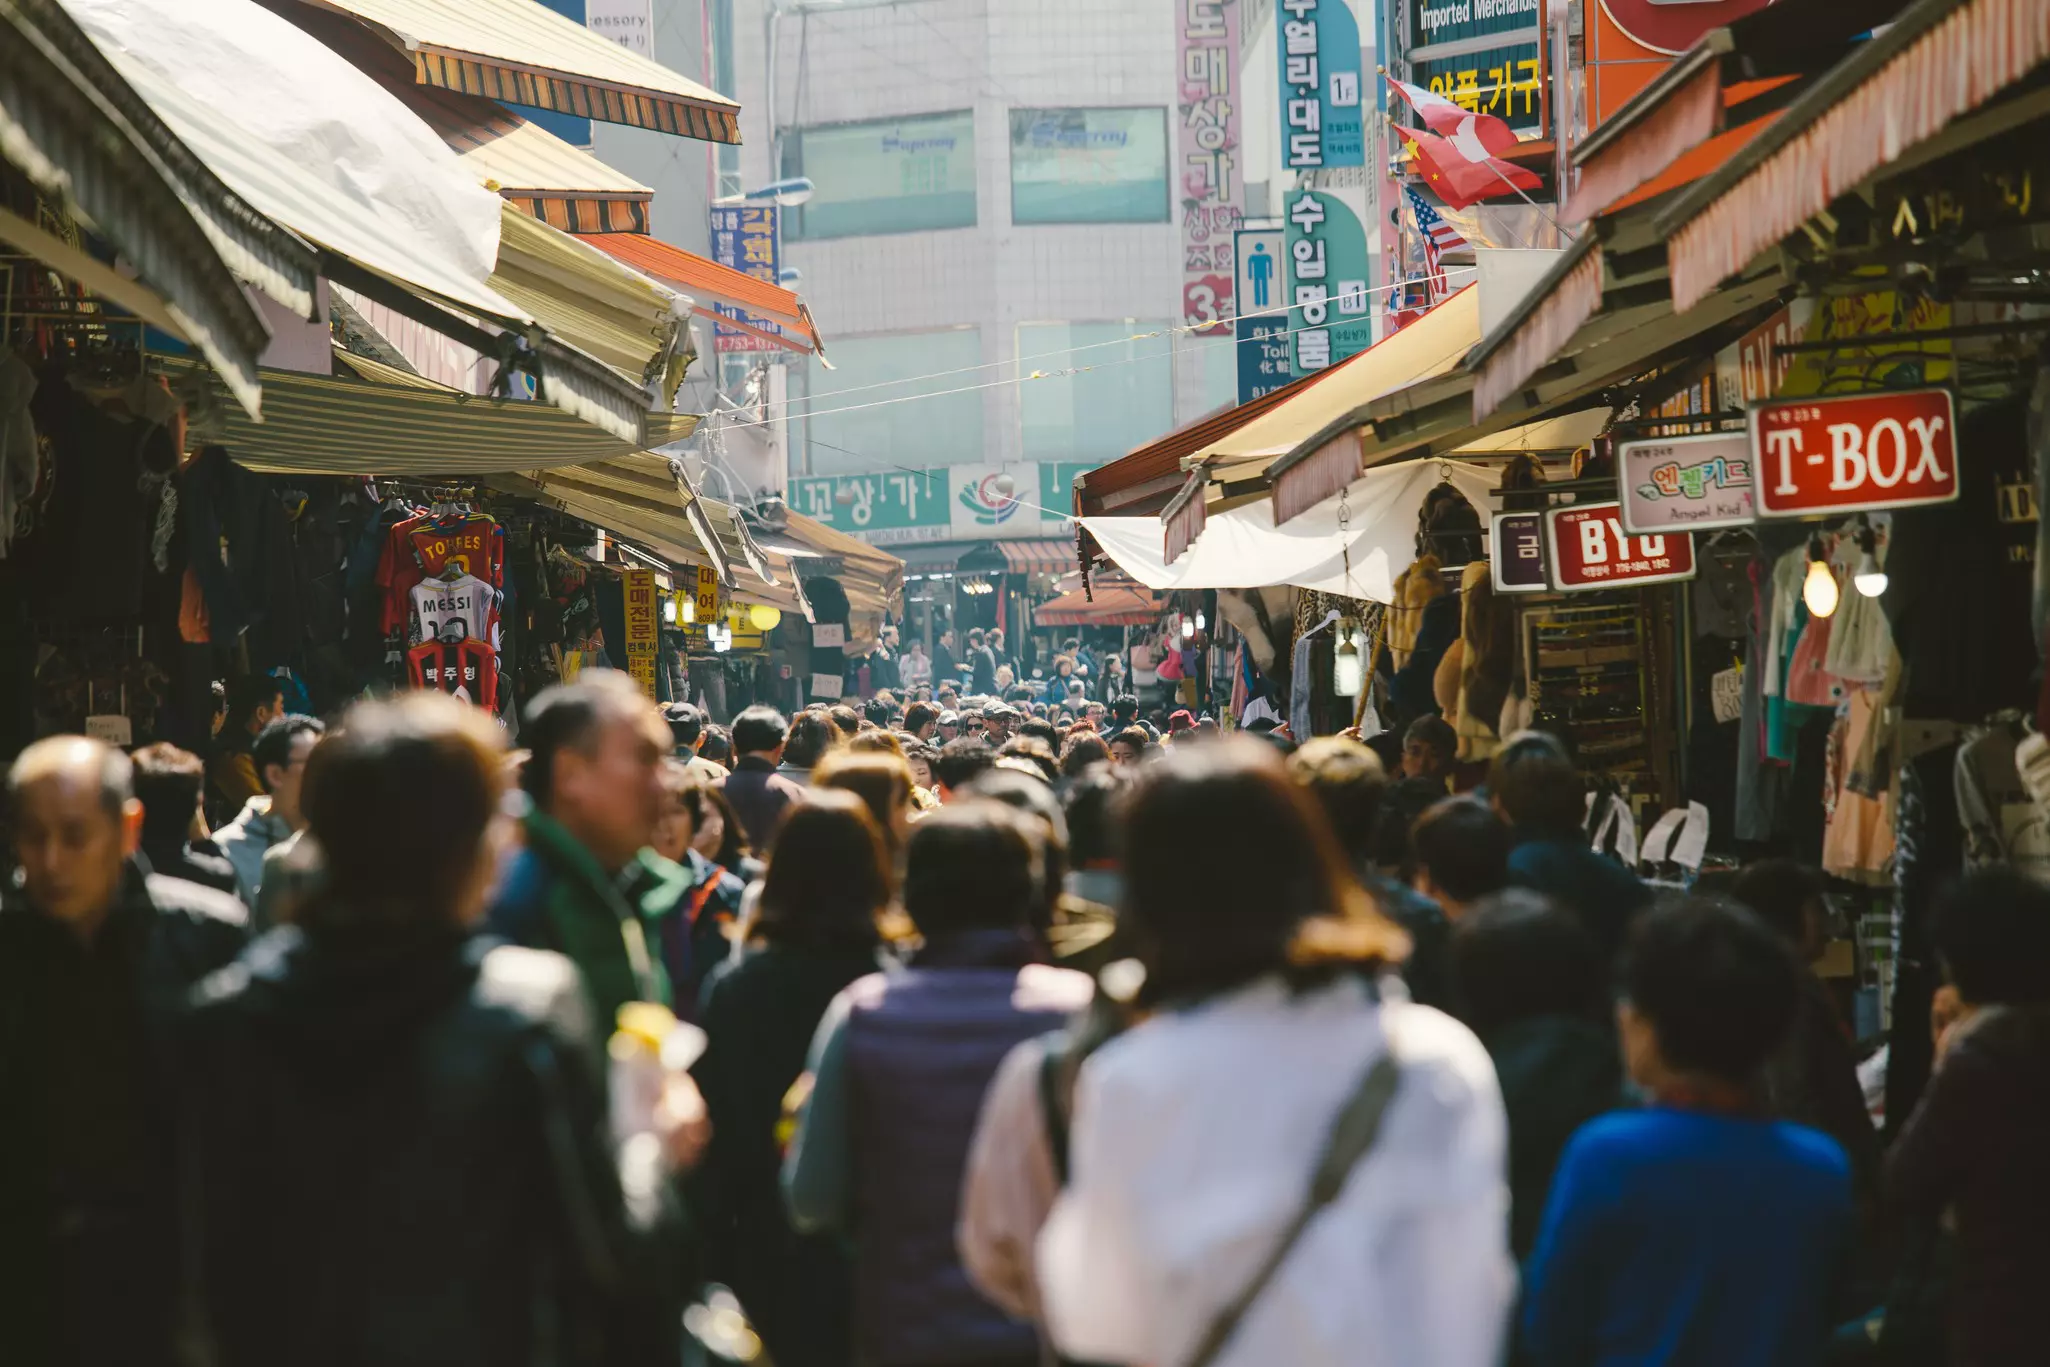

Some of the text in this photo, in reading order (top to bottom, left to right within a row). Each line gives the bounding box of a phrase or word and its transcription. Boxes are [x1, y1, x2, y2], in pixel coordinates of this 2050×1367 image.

[590, 15, 646, 28] essory
[1420, 0, 1538, 36] Imported Merchandis
[1291, 194, 1331, 369] 수입명품
[1260, 345, 1289, 367] Toil
[1766, 415, 1949, 497] T-BOX
[1653, 458, 1750, 497] 엔젤키드
[1671, 505, 1711, 520] Angel
[425, 536, 482, 560] TORRES
[423, 596, 472, 613] MESSI
[629, 571, 651, 640] 도매전문
[425, 666, 476, 682] 박주영
